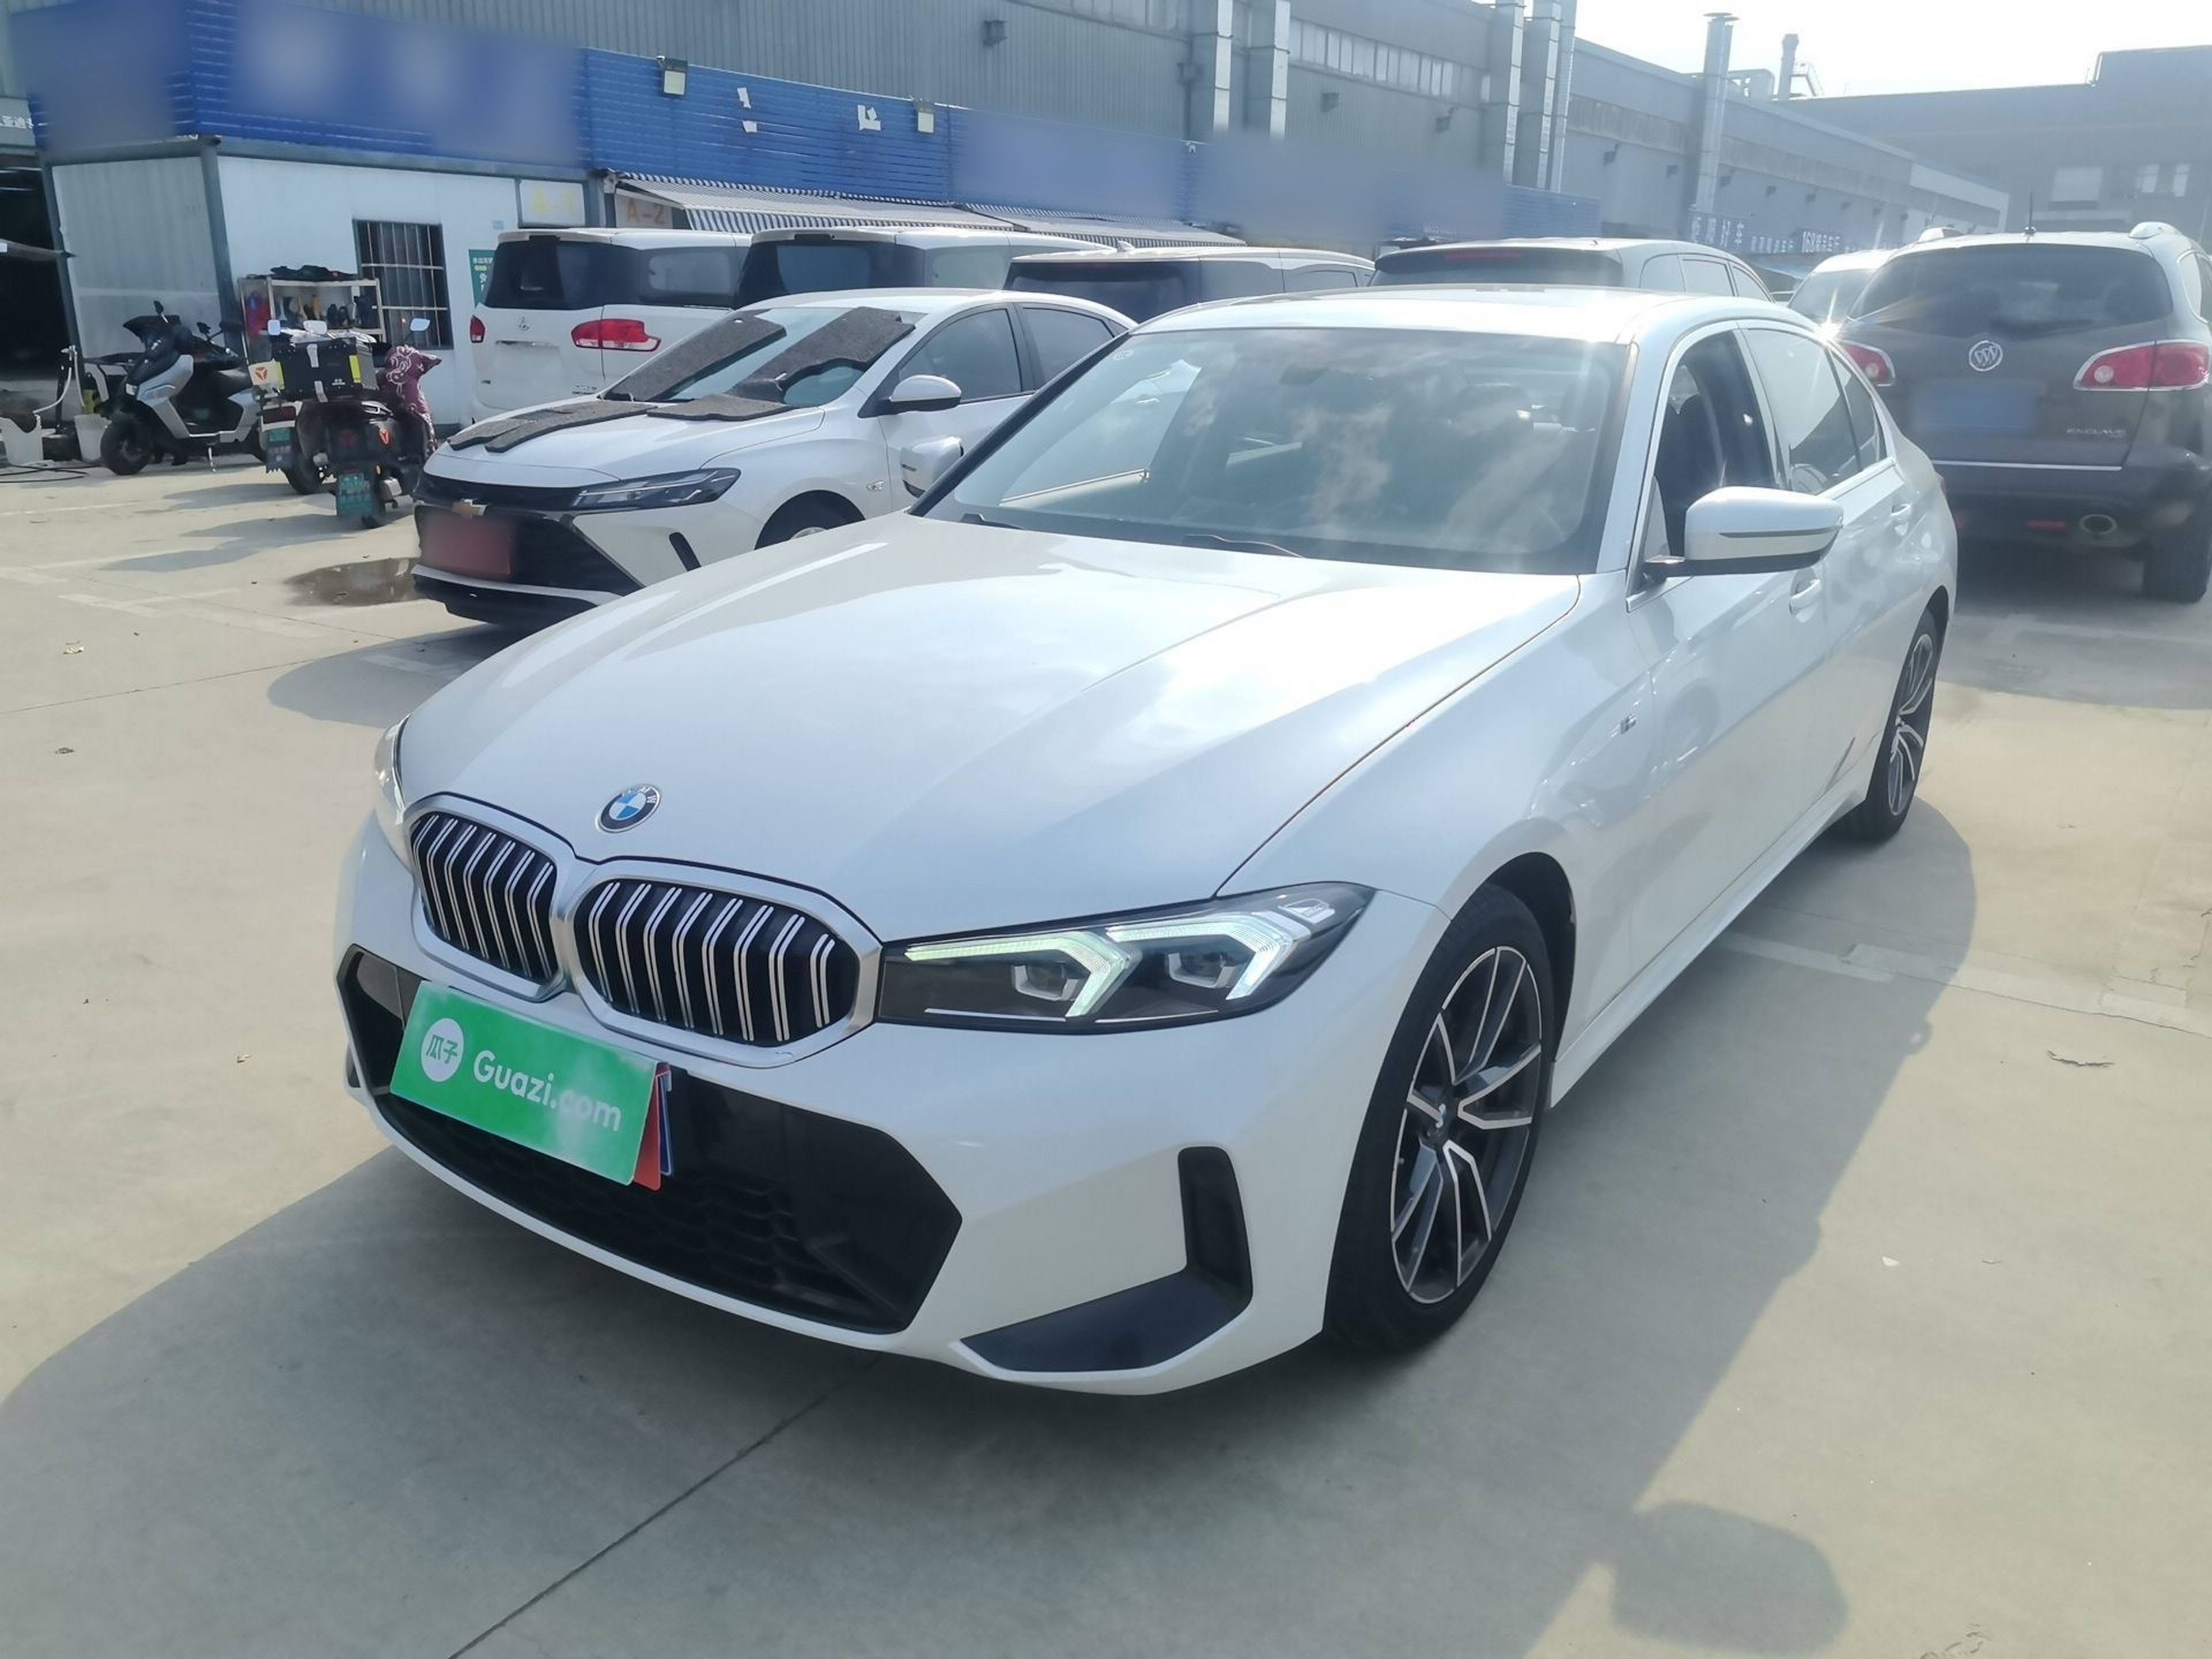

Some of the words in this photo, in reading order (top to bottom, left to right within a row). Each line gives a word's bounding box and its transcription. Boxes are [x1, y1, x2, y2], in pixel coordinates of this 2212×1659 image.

[627, 198, 665, 224] A-2
[426, 1034, 459, 1064] 瓜子
[474, 1050, 622, 1132] Guazi.com
